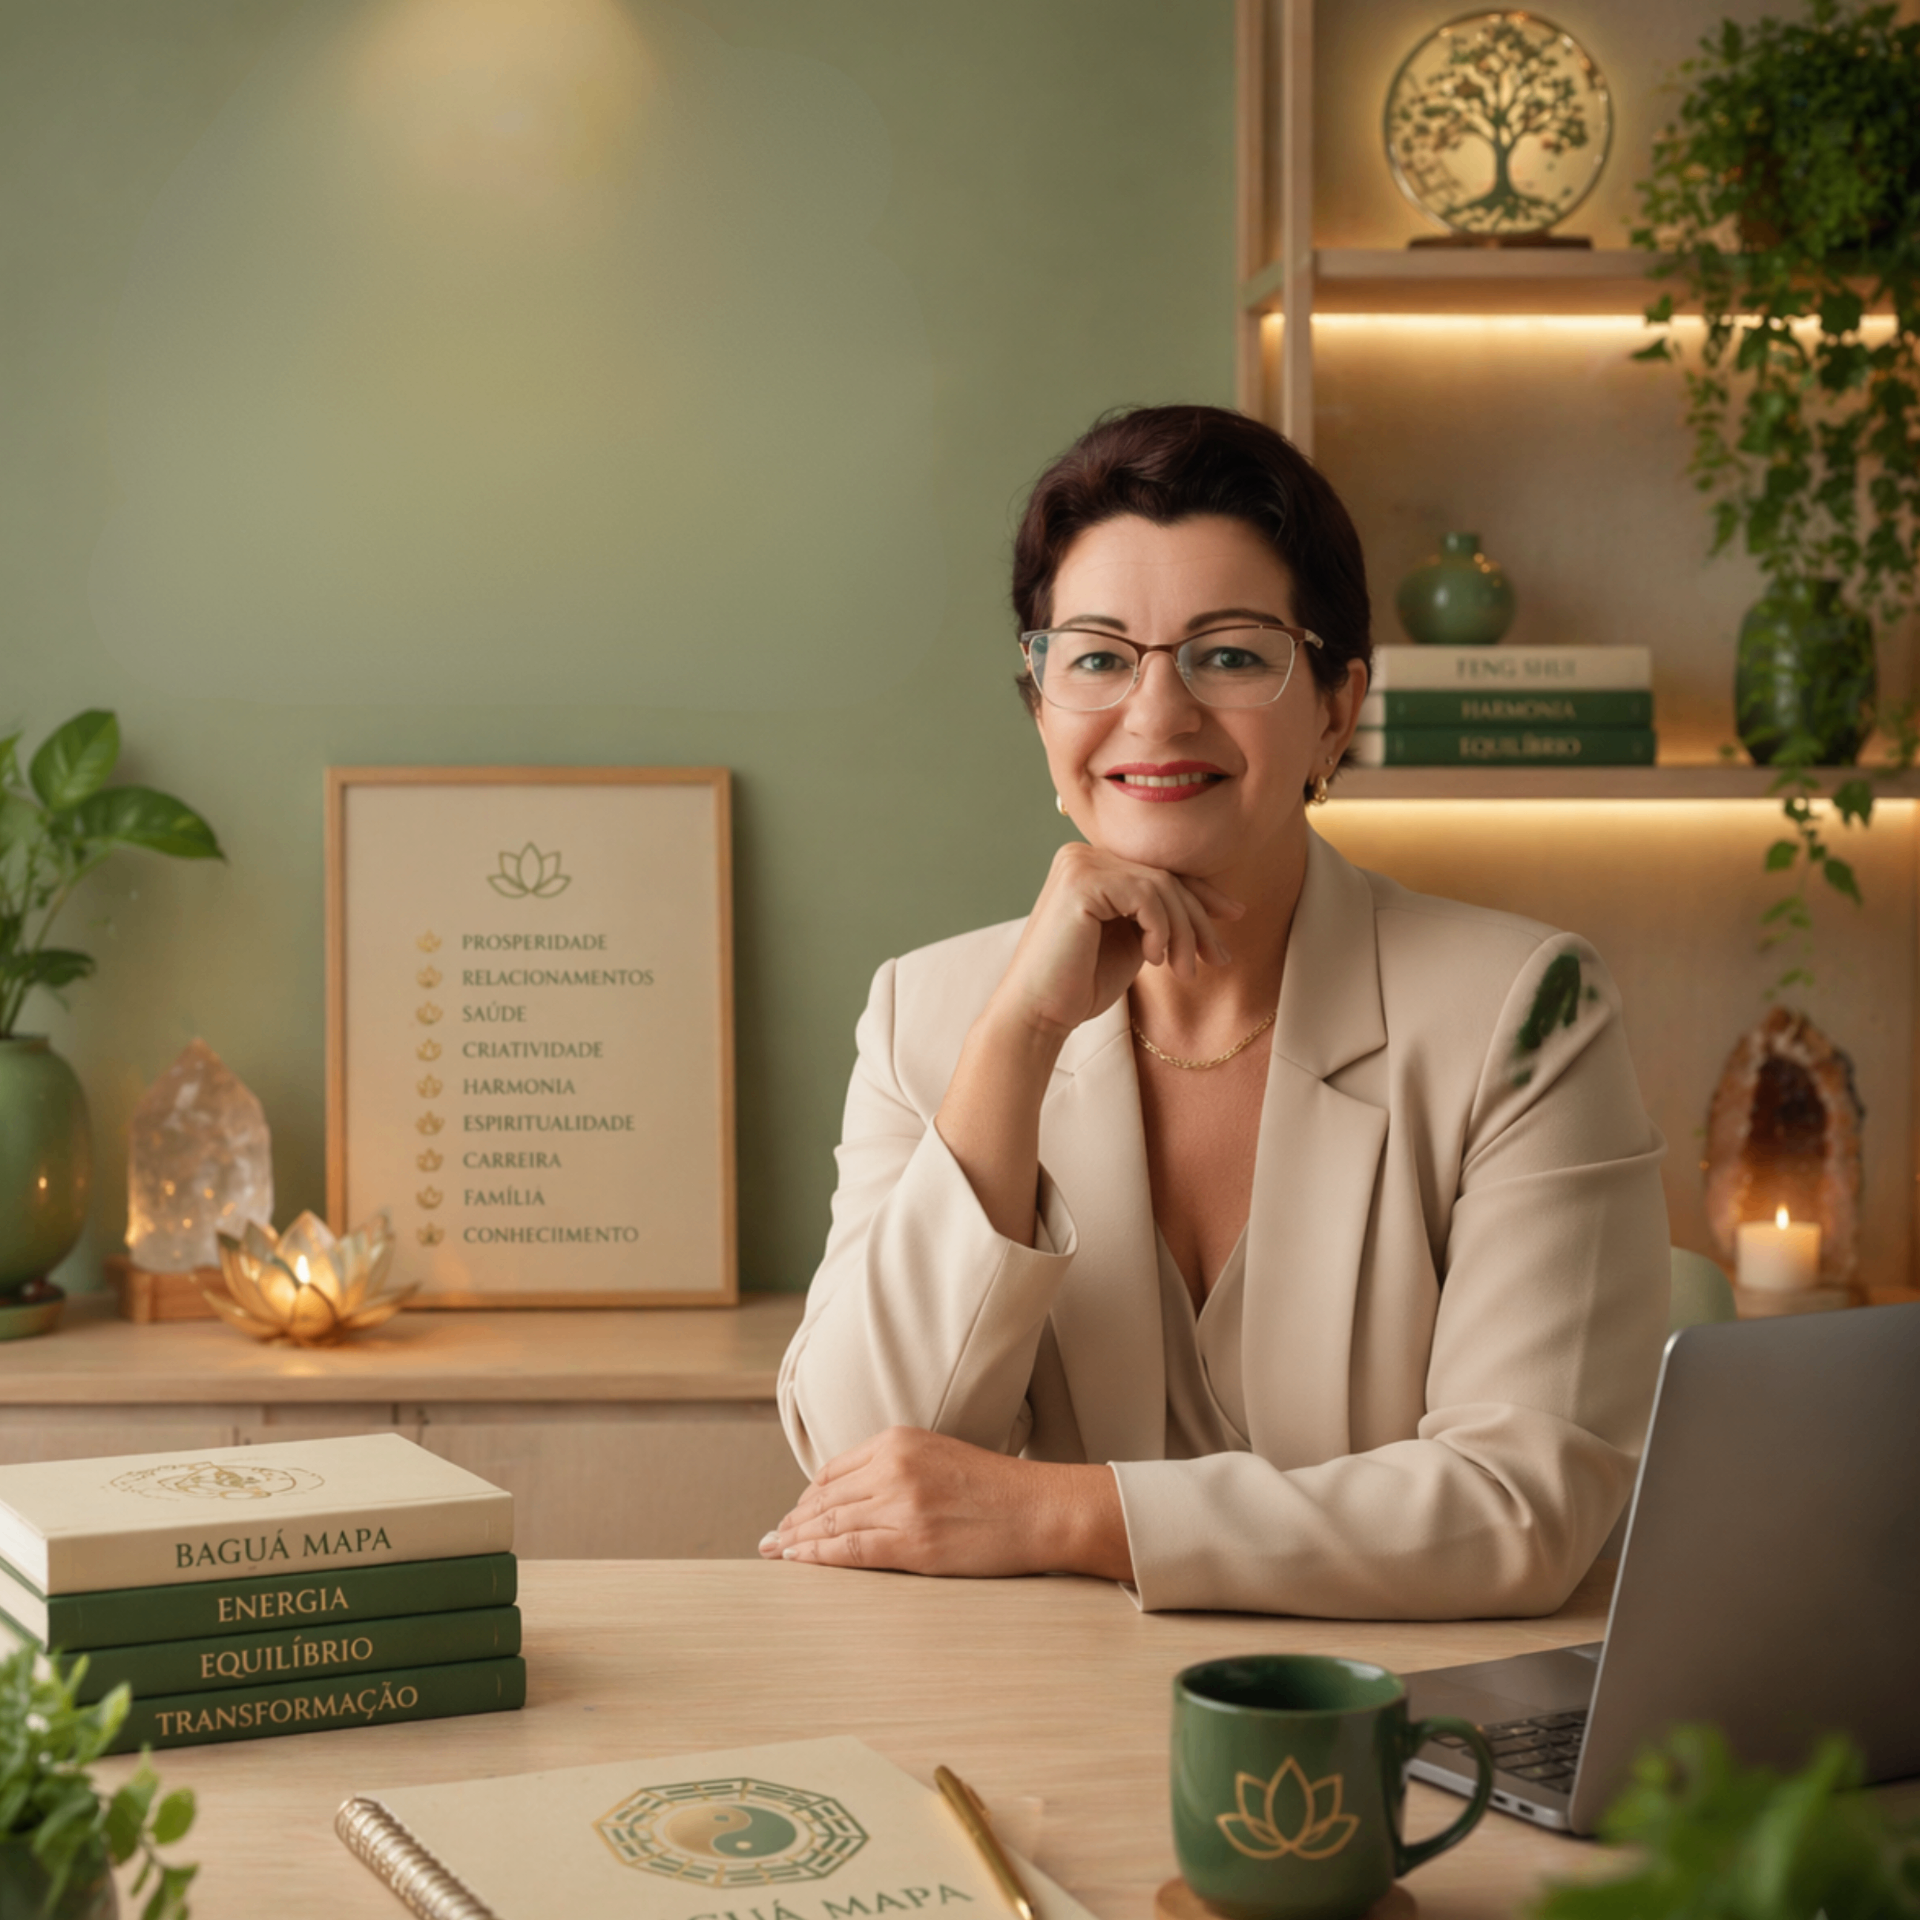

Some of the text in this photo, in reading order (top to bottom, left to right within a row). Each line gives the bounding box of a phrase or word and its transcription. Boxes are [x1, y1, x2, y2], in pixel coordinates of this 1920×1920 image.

[462, 934, 608, 951] PROSPERIDADE
[462, 969, 655, 987] RELACIONAMENTOS
[462, 1001, 527, 1022] SAÚDE
[462, 1041, 604, 1058] CRIATIVIDADE
[463, 1078, 576, 1095] HARMONIA
[463, 1114, 636, 1132] ESPIRITUALIDADE
[463, 1151, 562, 1169] CARREIRA
[463, 1186, 546, 1206] FAMÍLIA
[175, 1527, 393, 1569] BAGUÁ MAPA
[217, 1587, 349, 1623] ENERGIA
[200, 1636, 374, 1679] EQUILÍBRIO
[156, 1682, 419, 1737] TRANSFORMAÇÃO
[821, 1883, 974, 1920] MAPA
